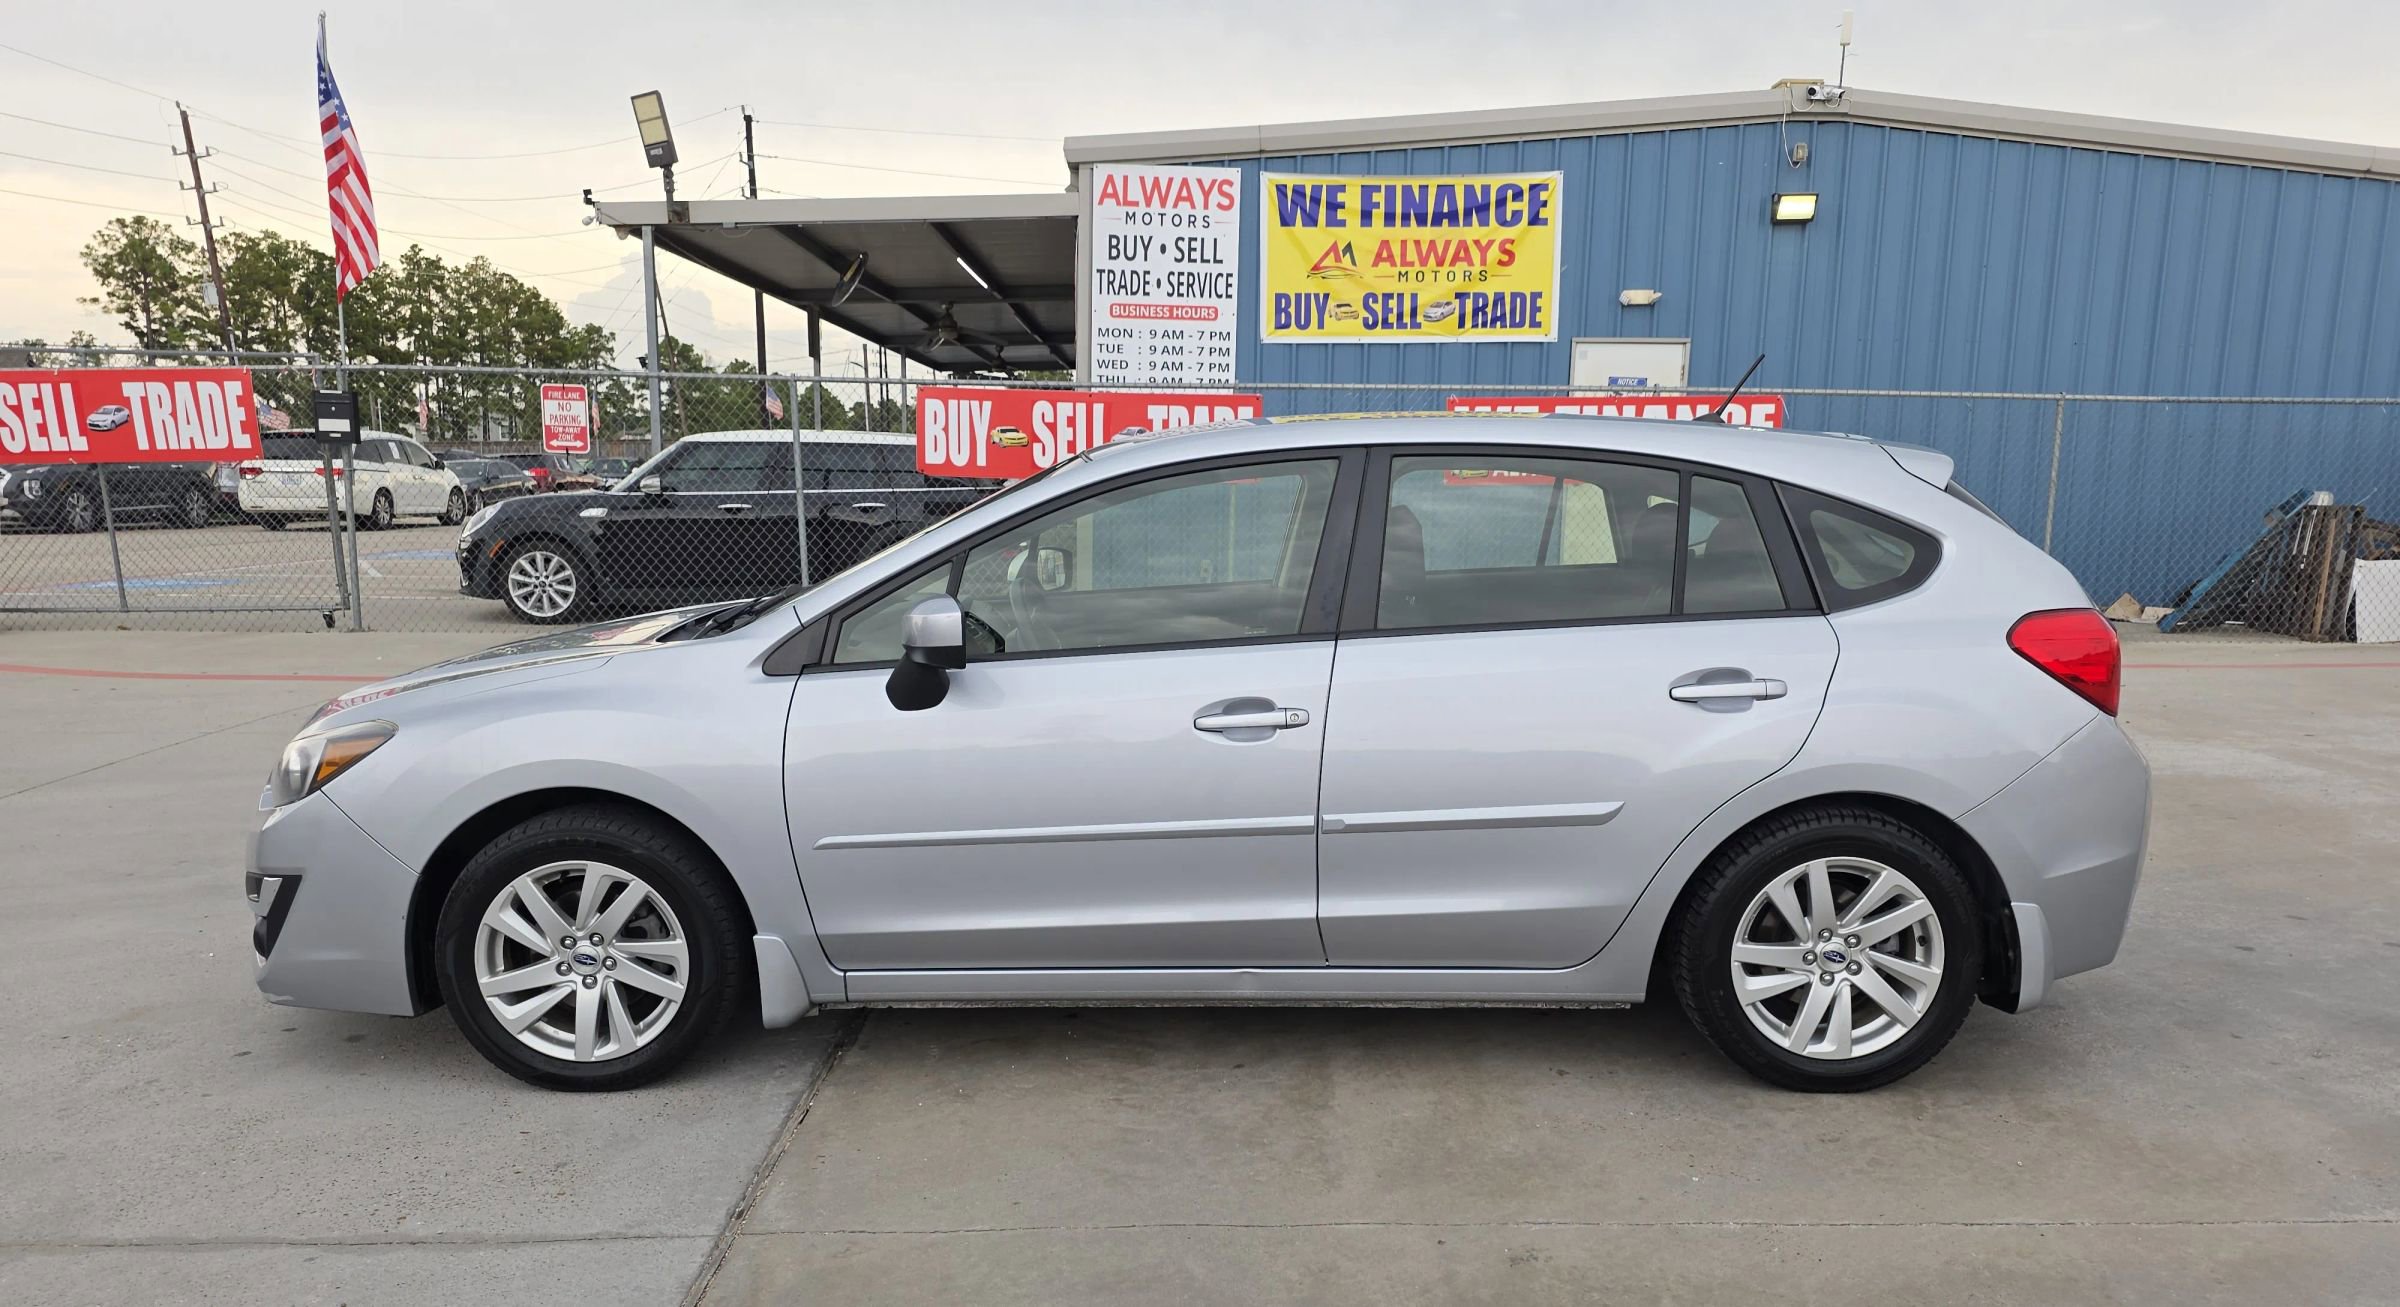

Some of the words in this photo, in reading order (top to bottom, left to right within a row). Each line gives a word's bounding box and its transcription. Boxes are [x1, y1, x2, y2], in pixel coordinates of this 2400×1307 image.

[1097, 173, 1235, 212] ALWAYS
[1275, 183, 1347, 228] WE
[1359, 183, 1550, 228] FINANCE
[1125, 211, 1210, 229] MOTORS
[1108, 234, 1153, 262] BUY
[1174, 236, 1224, 264] SELL
[1371, 238, 1516, 268] ALWAYS
[1096, 268, 1151, 297] TRADE
[1167, 271, 1234, 299] SERVICE
[1397, 270, 1488, 283] MOTORS
[1112, 305, 1170, 318] BUSINESS
[1173, 306, 1216, 319] HOURS
[1274, 292, 1330, 331] BUY
[1362, 292, 1422, 331] SELL
[1454, 291, 1543, 329] TRADE
[1097, 327, 1133, 338] MON
[1149, 329, 1157, 340] 9
[1161, 330, 1184, 340] AM
[1196, 330, 1205, 341] 7
[1209, 331, 1231, 341] PM
[1097, 343, 1124, 354] TUE
[1149, 345, 1157, 355] 9
[1161, 346, 1184, 356] AM
[1196, 346, 1205, 357] 7
[1209, 347, 1231, 357] PM
[1096, 359, 1129, 370] WED
[1149, 361, 1157, 371] 9
[1161, 362, 1184, 372] AM
[1196, 362, 1205, 373] 7
[1209, 363, 1231, 373] PM
[1617, 378, 1639, 386] NOTICE
[548, 391, 562, 399] FIRE
[558, 402, 572, 412] NO
[121, 380, 252, 451] TRADE
[550, 414, 582, 425] PARKING
[924, 398, 992, 467] BUY
